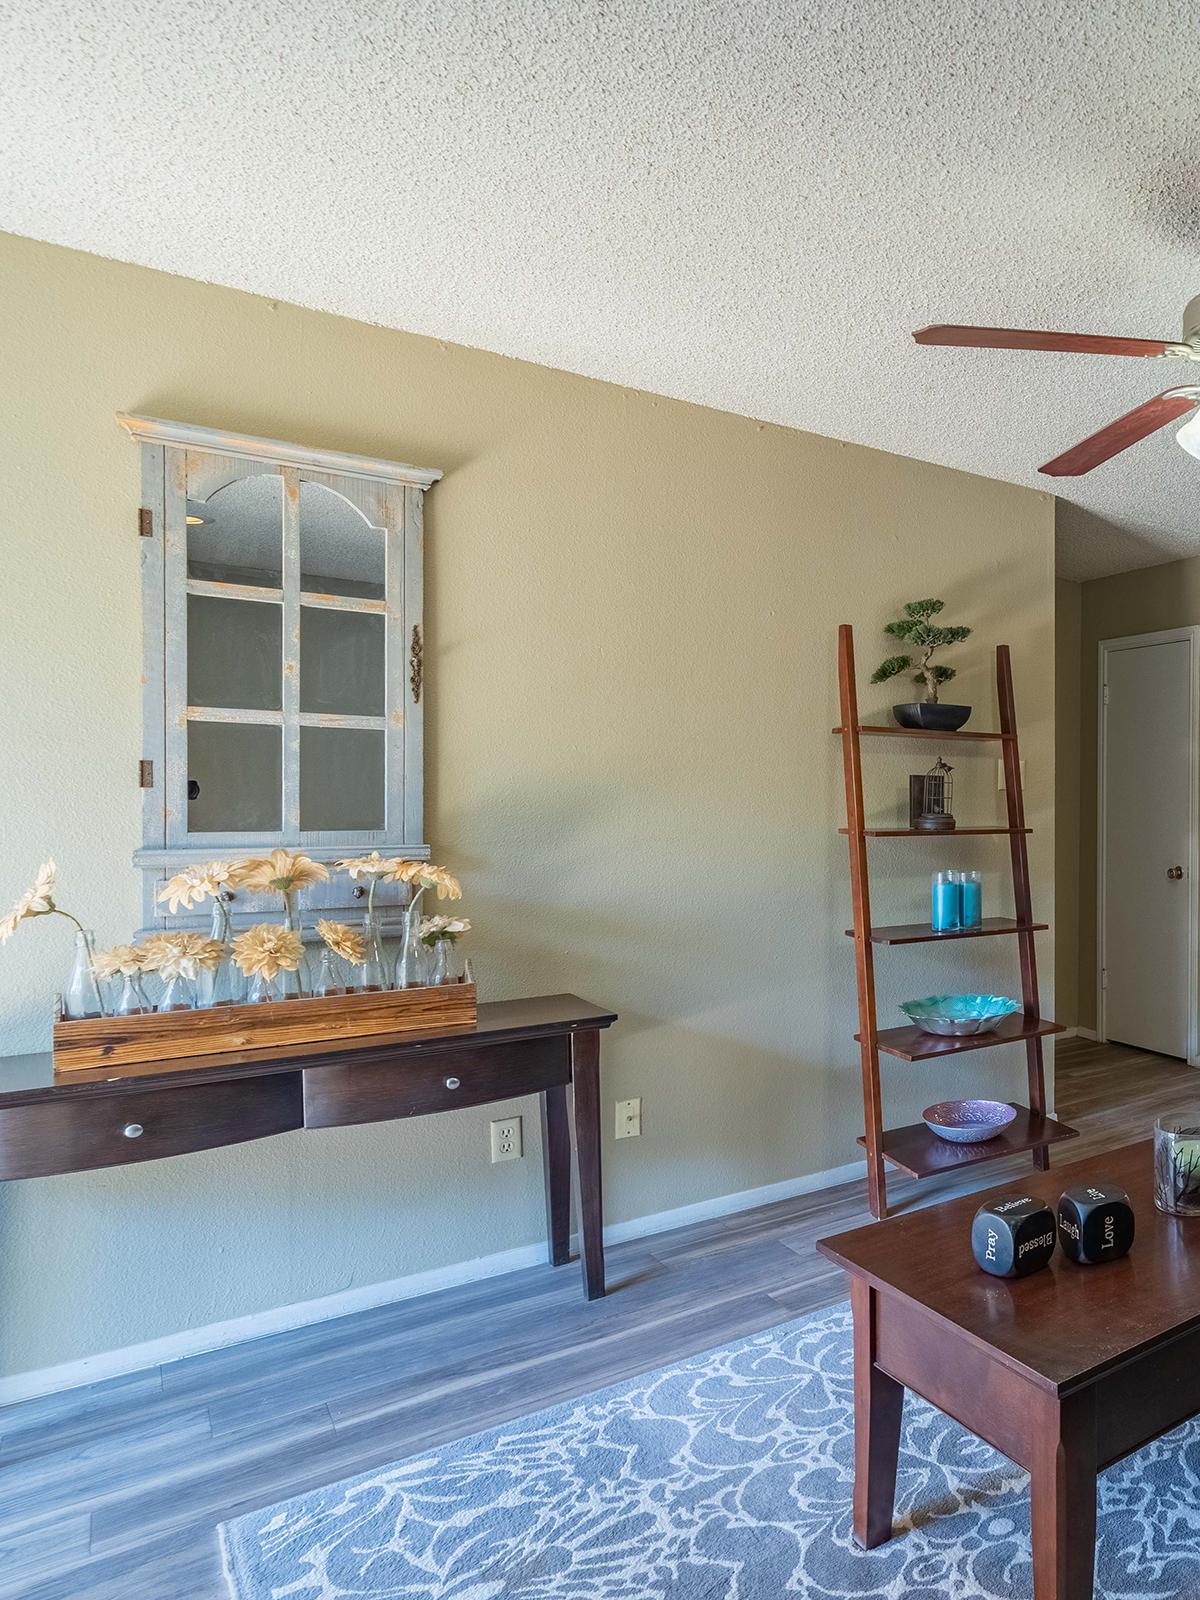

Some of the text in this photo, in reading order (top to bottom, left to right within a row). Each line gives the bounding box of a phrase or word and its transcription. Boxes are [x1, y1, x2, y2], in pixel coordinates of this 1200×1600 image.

[994, 1196, 1032, 1214] Believe
[1059, 1213, 1080, 1240] Laugh
[1101, 1215, 1114, 1250] Love
[985, 1228, 1000, 1262] Pray
[1018, 1231, 1054, 1259] Blessed
